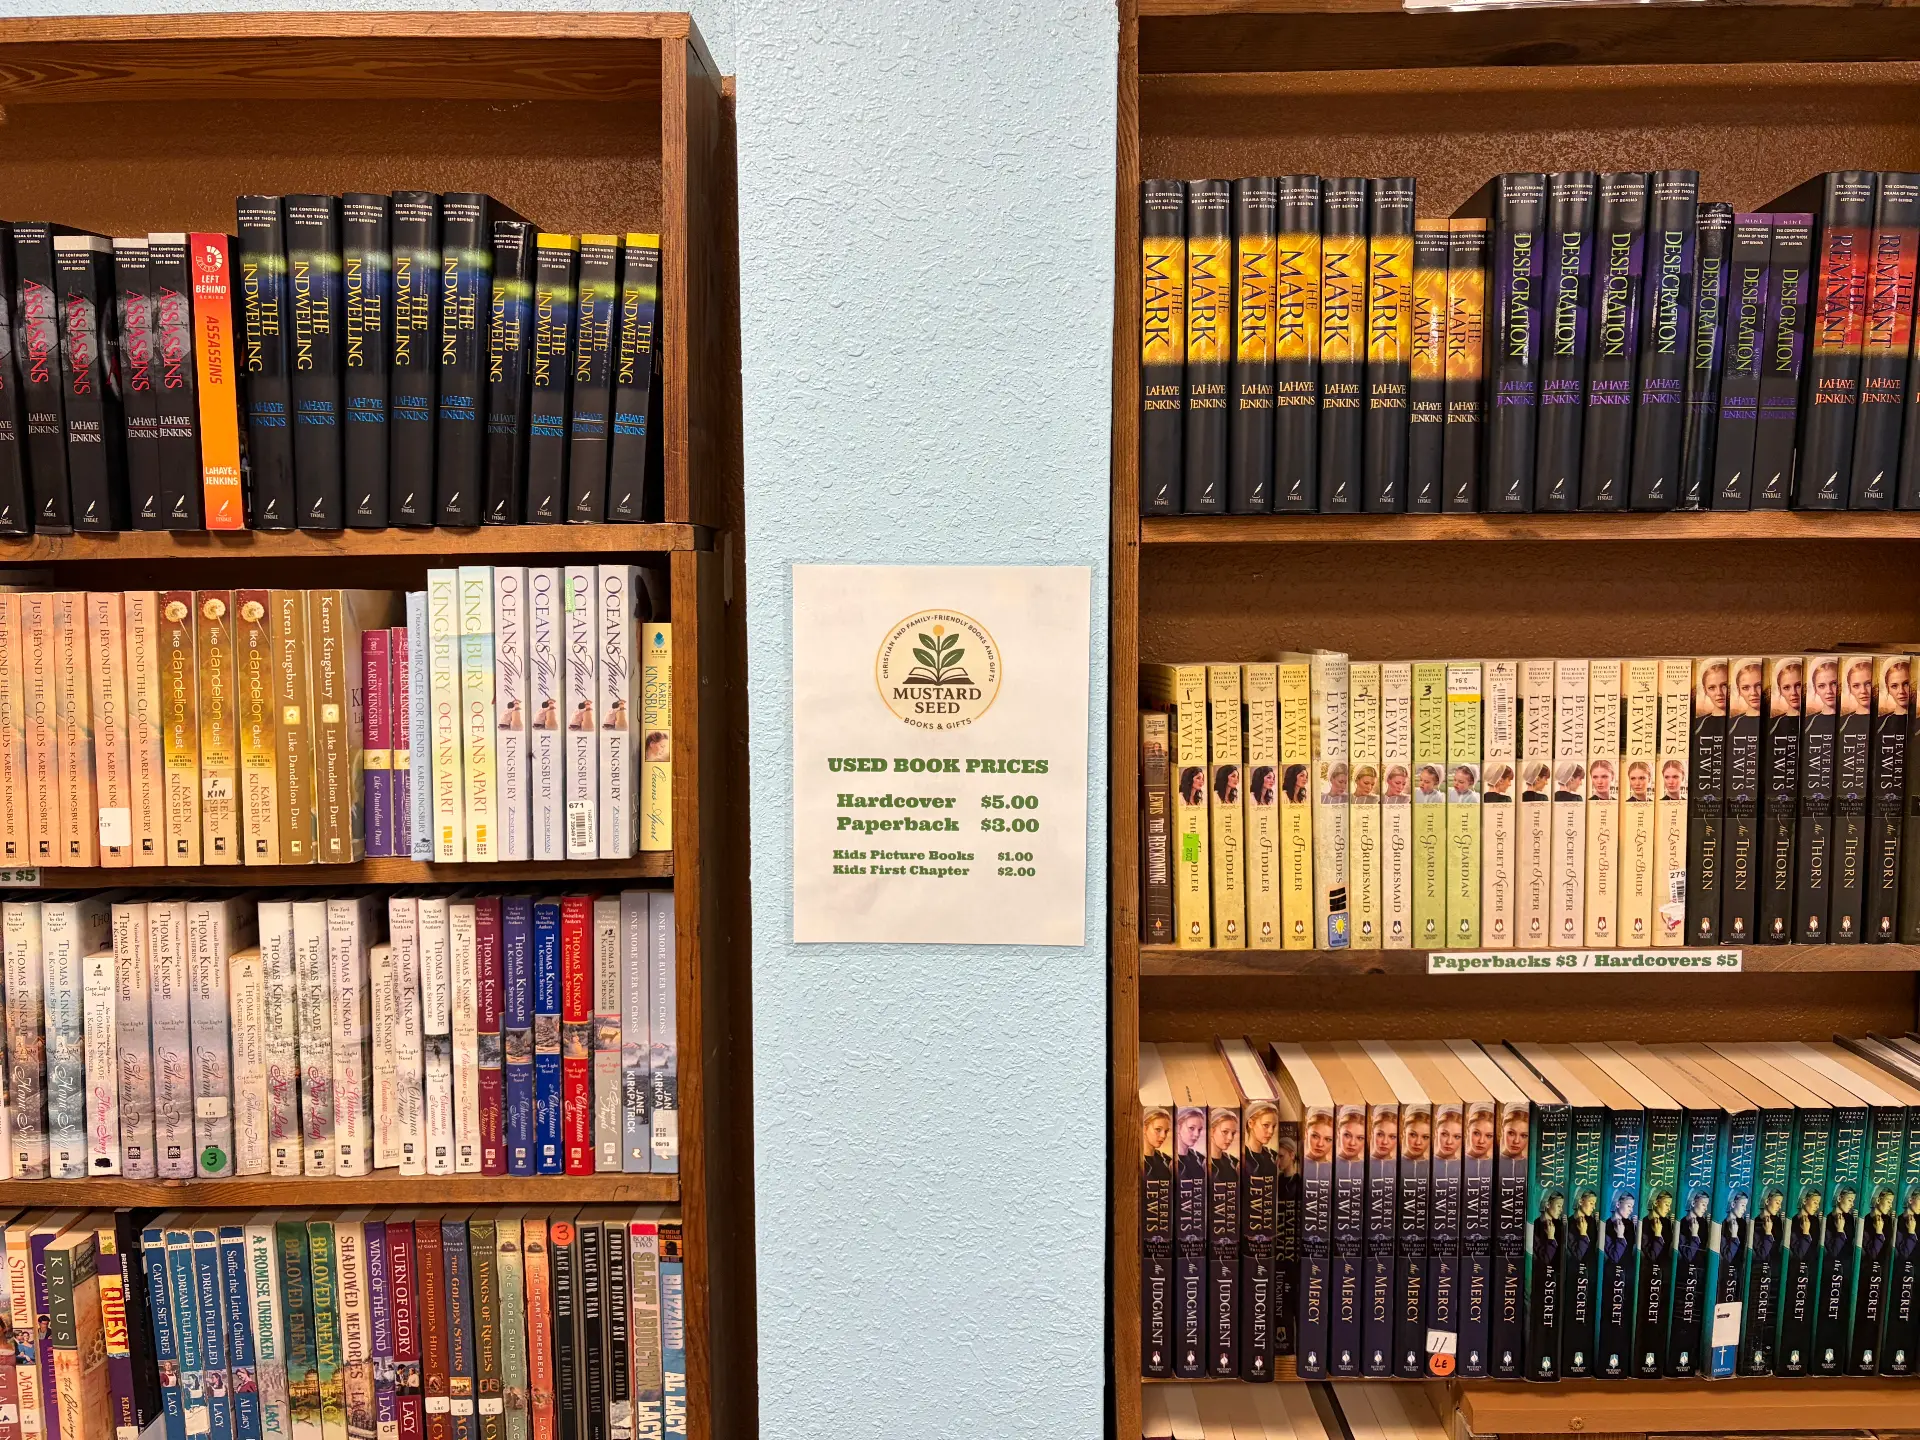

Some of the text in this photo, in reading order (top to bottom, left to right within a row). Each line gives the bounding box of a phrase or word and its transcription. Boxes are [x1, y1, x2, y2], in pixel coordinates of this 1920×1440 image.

[200, 275, 219, 283] LEFT
[206, 254, 213, 263] 6
[195, 284, 226, 294] BEHIND
[242, 262, 262, 372] INDWELLING
[260, 298, 280, 336] THE
[1144, 252, 1169, 348] MARK
[1171, 283, 1183, 315] THE
[1509, 231, 1532, 357] DESECRATION
[1823, 233, 1854, 348] REMNANT
[1851, 271, 1865, 313] THE
[23, 278, 48, 383] ASSASSINS
[67, 292, 91, 395] ASSASSINS
[1735, 267, 1759, 372] DESECRATION
[205, 315, 222, 384] ASSASSINS
[613, 424, 645, 435] JENKINS
[1144, 399, 1181, 411] JENKINS
[70, 432, 100, 442] JENKINS
[205, 476, 238, 485] JENKINS
[500, 575, 517, 662] OCEANS
[882, 641, 895, 678] CHRISTIAN
[893, 627, 906, 640] AND
[906, 614, 968, 629] FAMILY-FRIENDLY
[967, 623, 986, 644] BOOKS
[984, 645, 993, 660] AND
[132, 597, 151, 833] JUST BEYOND THE CLOUDS KAREN KINGSBURY
[172, 629, 186, 749] like dandelion dust
[432, 580, 453, 816] KINGSBURY OCEANS APART
[893, 687, 981, 701] MUSTARD
[914, 701, 960, 714] SEED
[1423, 685, 1432, 696] 3
[903, 716, 934, 729] BOOKS
[945, 717, 972, 730] GIFTS
[1215, 699, 1227, 759] LEWIS
[1227, 698, 1237, 759] BEVERLY
[207, 788, 226, 798] KIN
[505, 735, 516, 802] KINGSBURY
[827, 757, 1048, 774] USED BOOK PRICES
[836, 793, 1038, 809] Hardcover $5.00
[836, 816, 1039, 834] Paperback $3.00
[832, 849, 1033, 862] Kids Picture Books $1.00
[1149, 791, 1167, 885] LEWIS THE RECKONING
[1223, 814, 1236, 892] THE FIDDLER
[1419, 812, 1437, 898] THE GUARDIAN
[1702, 824, 1716, 891] the THORN
[15, 869, 36, 882] $5
[832, 864, 1036, 878] Kids First Chapter $2.00
[1390, 833, 1404, 913] BRIDESMAID
[1599, 860, 1610, 896] BRIDE
[1669, 871, 1685, 879] 279
[434, 938, 446, 1026] THOMAS KINKADE
[483, 934, 494, 1023] THOMAS KINKADE
[1432, 953, 1738, 970] Paperbacks $3 / Hardcovers $5
[626, 1070, 636, 1133] KIRKPATRICK
[635, 1089, 644, 1114] JANE
[206, 1153, 218, 1166] 3
[1541, 1131, 1556, 1188] LEWIS
[1554, 1131, 1567, 1189] BEVERLY
[557, 1225, 569, 1240] 3
[1146, 1179, 1160, 1232] LEWIS
[1159, 1179, 1170, 1232] BEVERLY
[121, 1253, 129, 1283] BREAKING
[226, 1250, 237, 1278] Suffer
[253, 1247, 270, 1299] PROMISE
[101, 1287, 128, 1351] QUEST
[152, 1263, 170, 1355] CAPTIVE SET FREE
[230, 1295, 240, 1320] Little
[311, 1236, 336, 1368] BELOVED ENEMY
[340, 1236, 363, 1379] SHADOWED MEMORIES
[393, 1243, 411, 1355] TURN OF GLORY
[480, 1261, 493, 1372] WINGS OF RICHES
[505, 1264, 516, 1379] ONE MORE SUNRISE
[662, 1274, 683, 1350] BLIZZARD
[1149, 1264, 1166, 1346] the JUDGMENT
[1308, 1264, 1322, 1324] the MERCY
[1543, 1265, 1556, 1328] the SECRET
[232, 1322, 244, 1360] Children
[257, 1300, 274, 1360] UNBROKEN
[166, 1391, 177, 1416] LACY
[382, 1425, 395, 1433] CF
[402, 1400, 416, 1433] LACY
[664, 1372, 686, 1435] AL LACY
